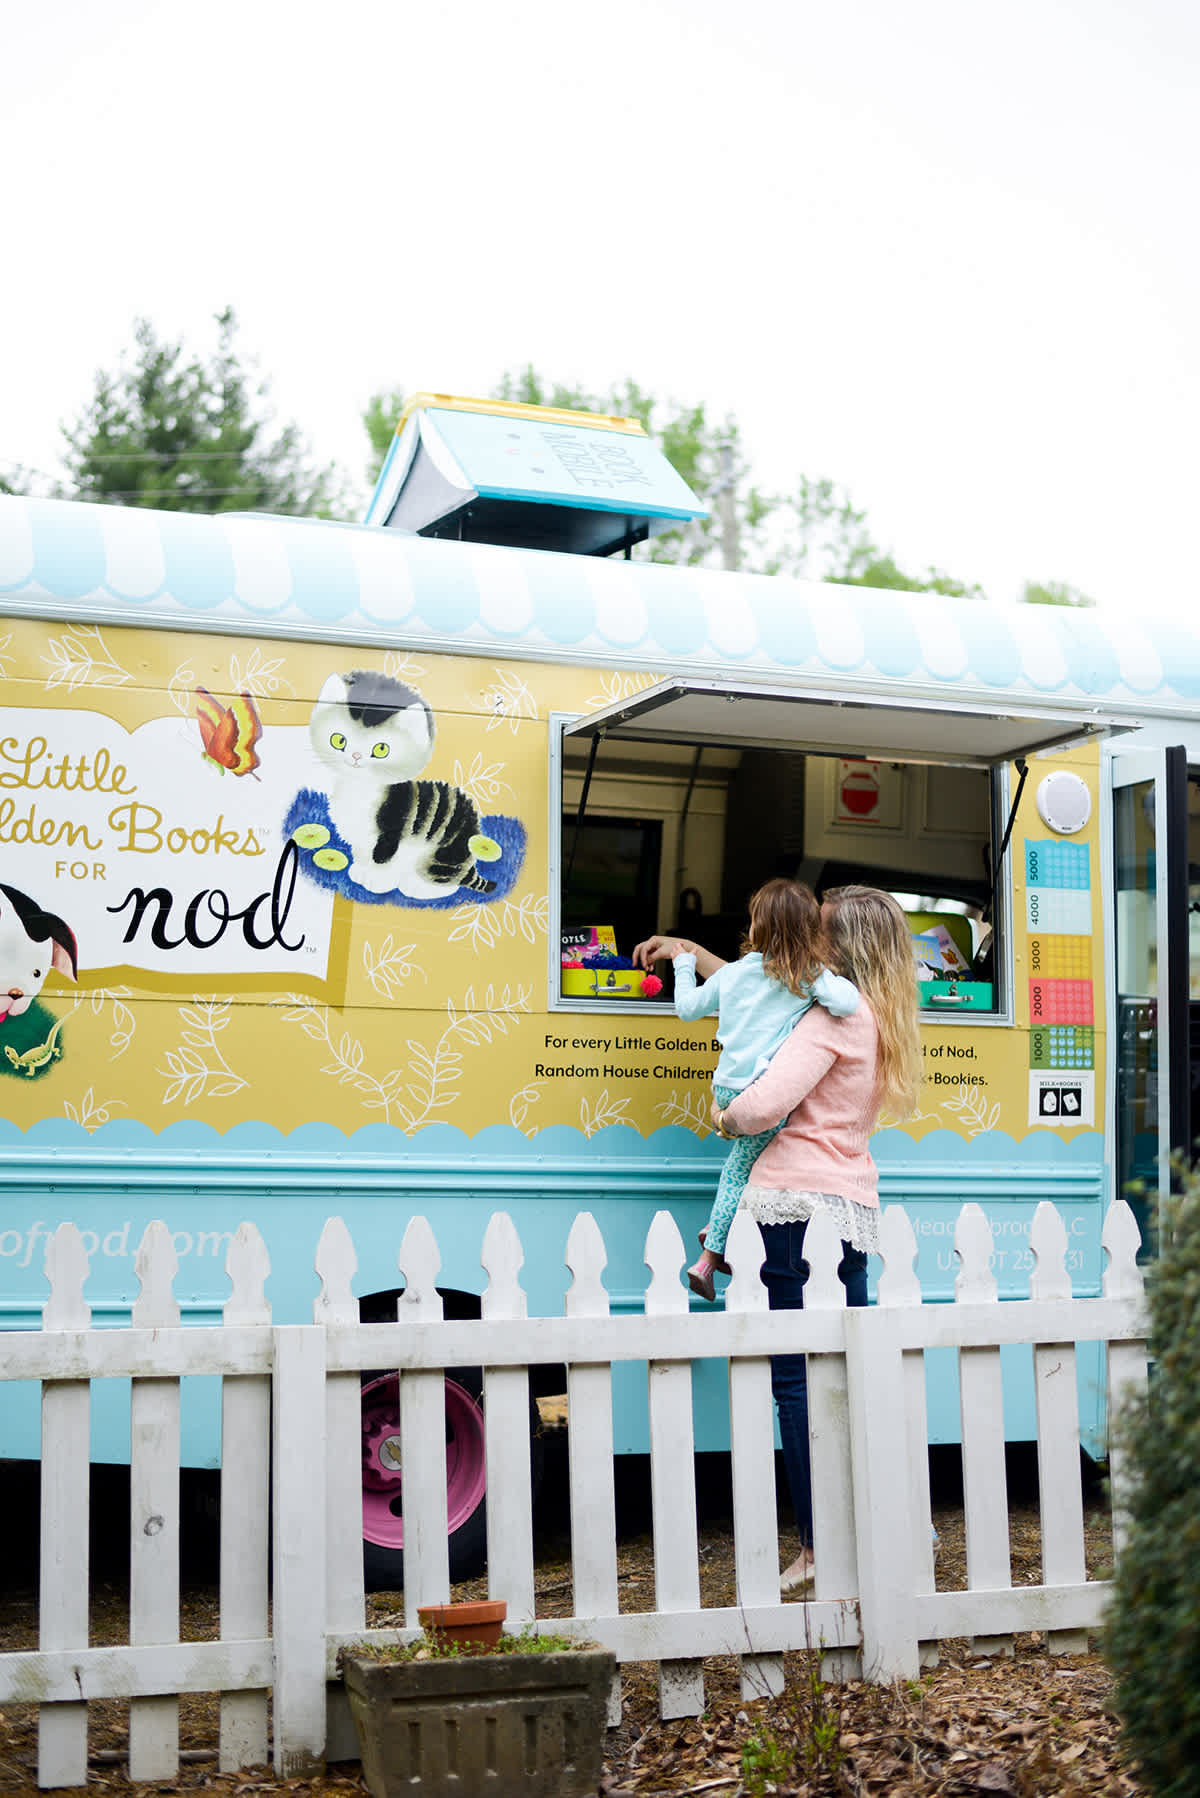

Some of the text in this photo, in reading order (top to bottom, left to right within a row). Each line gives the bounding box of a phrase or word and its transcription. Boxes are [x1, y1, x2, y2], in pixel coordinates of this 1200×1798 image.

[0, 736, 137, 795] Little
[0, 797, 103, 851] lden
[108, 801, 265, 856] Books
[55, 861, 107, 881] FOR
[1029, 850, 1039, 881] 5000
[106, 838, 305, 951] nod
[1030, 894, 1040, 925] 4000
[1031, 940, 1041, 971] 3000
[1032, 986, 1043, 1016] 2000
[544, 1035, 568, 1048] For
[571, 1039, 611, 1052] every
[615, 1037, 651, 1050] Little
[655, 1037, 707, 1051] Golden
[929, 1045, 944, 1057] of
[946, 1046, 978, 1059] Nod,
[1033, 1033, 1043, 1061] 1000
[535, 1064, 599, 1077] Random
[603, 1065, 649, 1078] House
